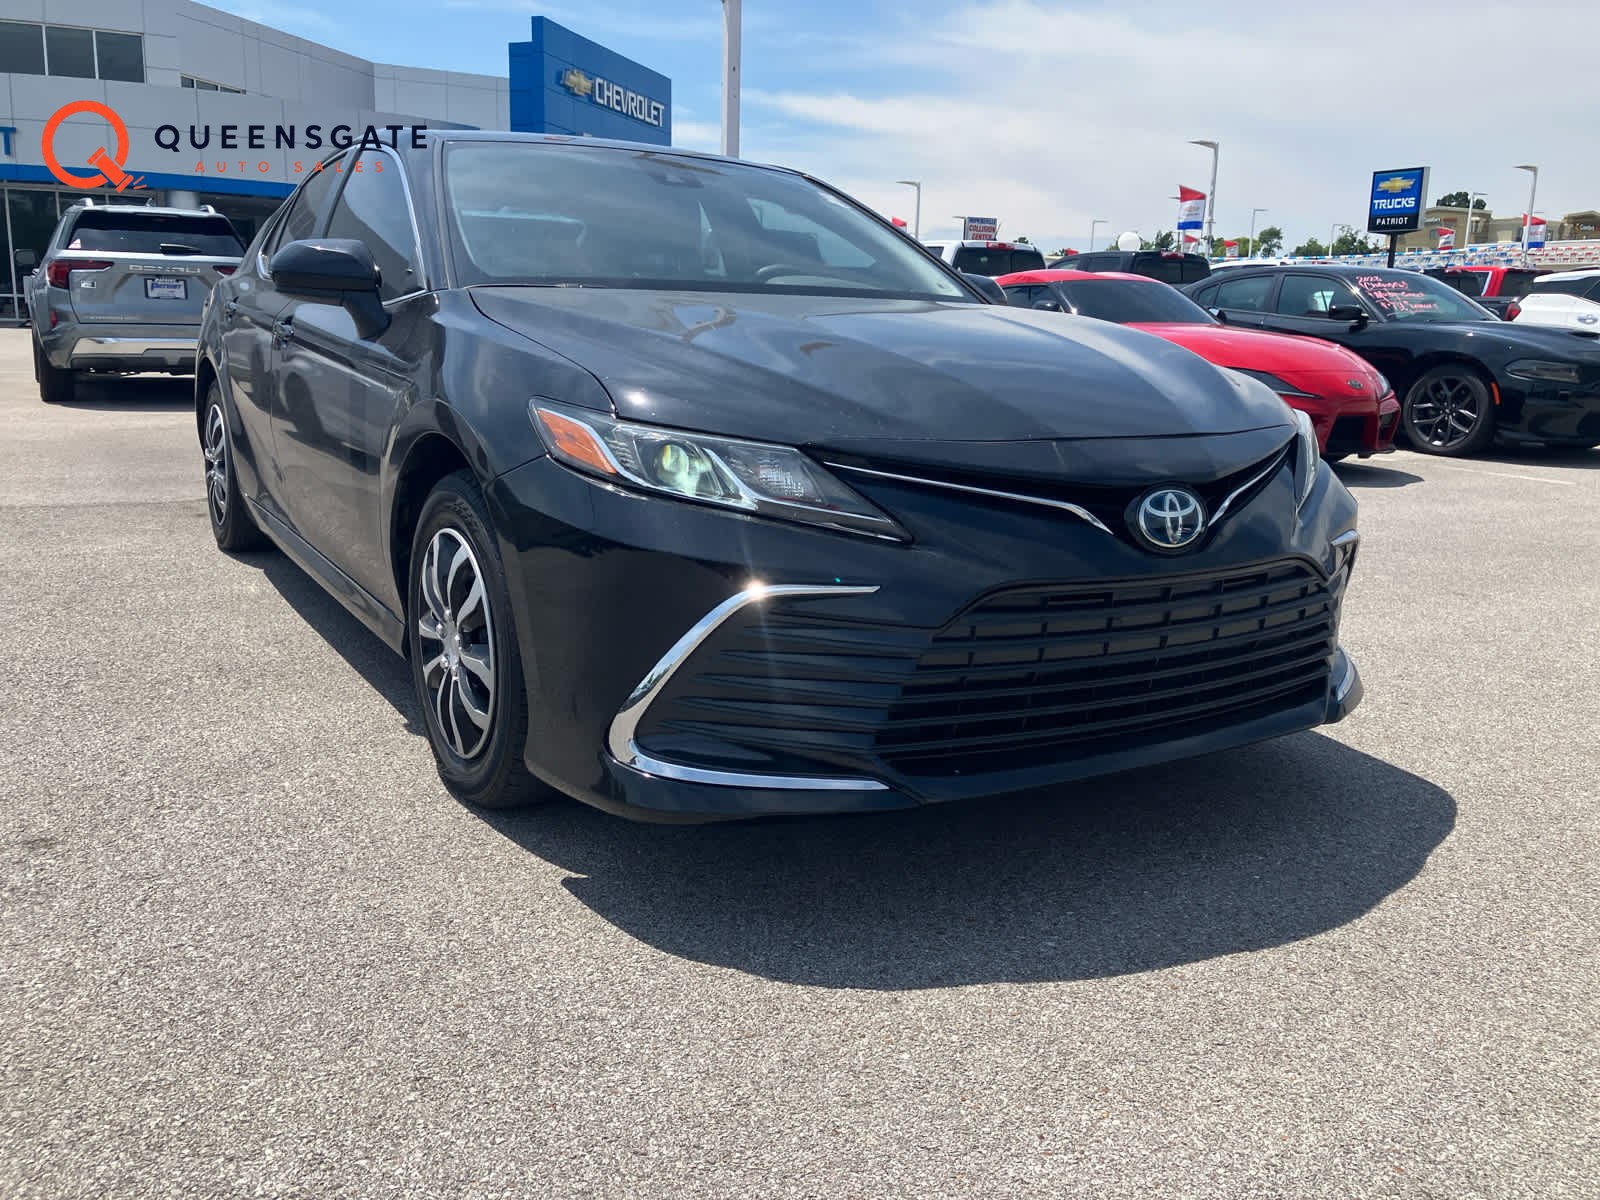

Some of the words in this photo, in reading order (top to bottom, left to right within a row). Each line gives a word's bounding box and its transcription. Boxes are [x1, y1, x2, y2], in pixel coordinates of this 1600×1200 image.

[594, 77, 665, 127] CHEVROLET
[1373, 197, 1416, 209] TRUCKS
[1376, 217, 1408, 225] PATRIOT
